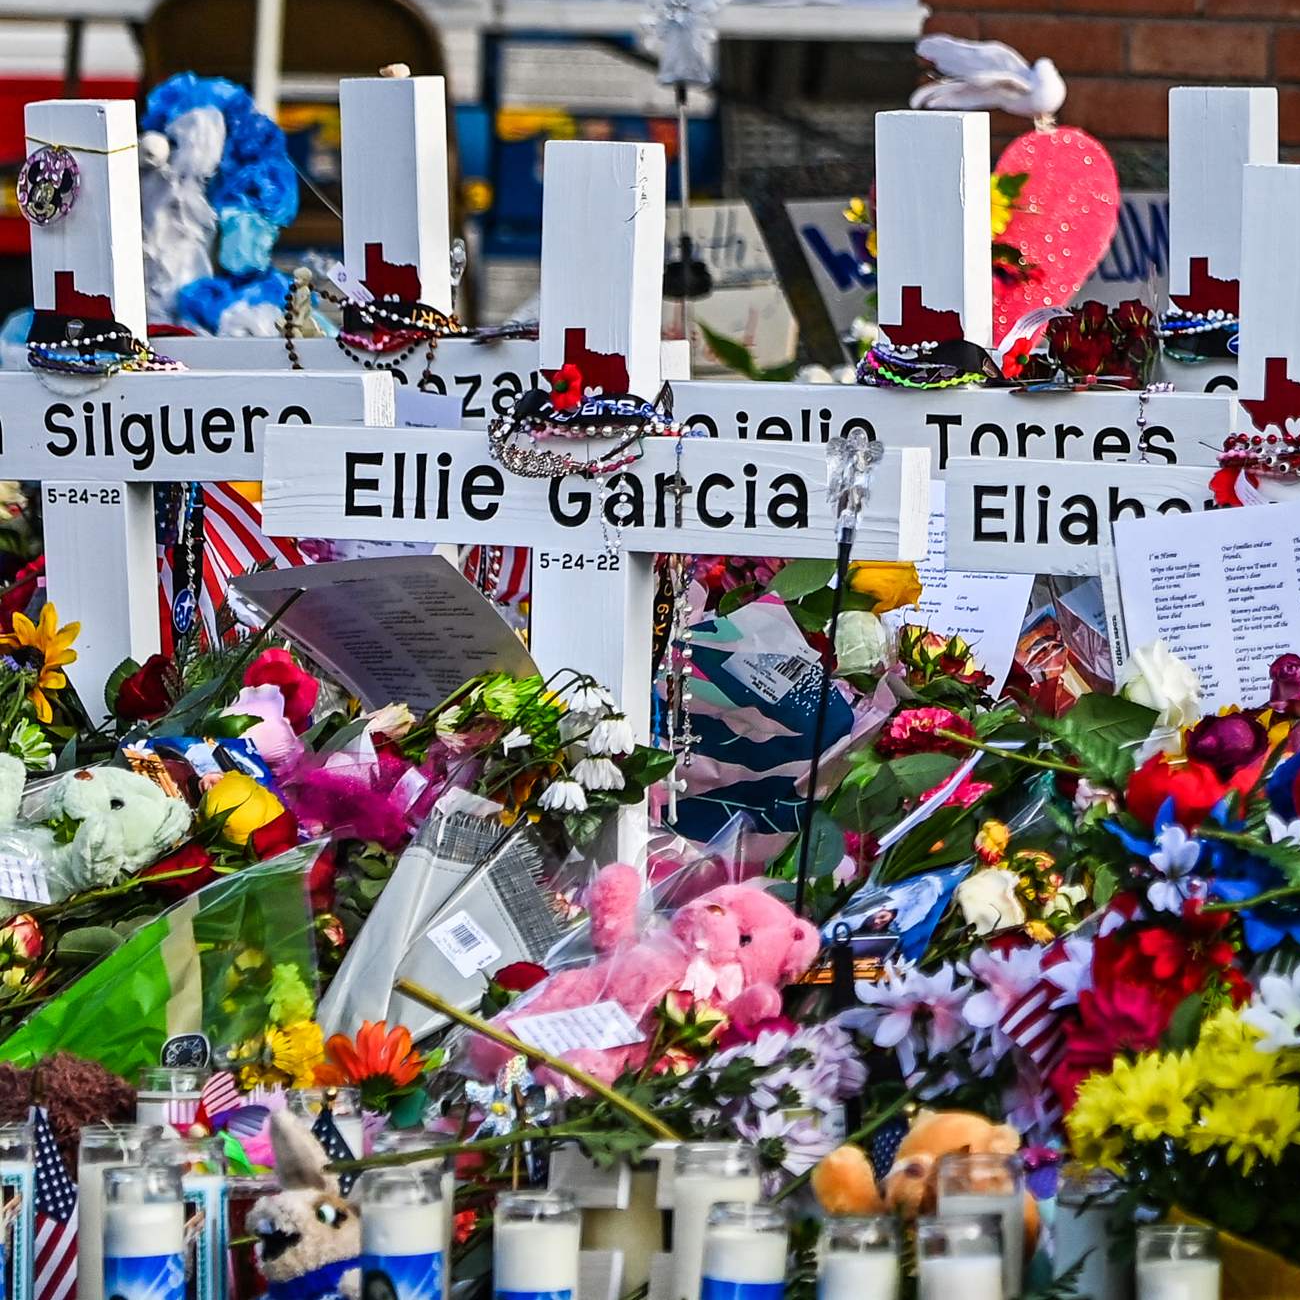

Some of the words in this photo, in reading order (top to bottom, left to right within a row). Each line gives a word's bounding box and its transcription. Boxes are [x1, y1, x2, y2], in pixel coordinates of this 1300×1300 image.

[539, 399, 637, 422] SUBRU
[926, 413, 1176, 471] Torres
[47, 486, 121, 505] 5-24-22
[344, 451, 505, 521] Ellie
[547, 464, 809, 530] Garcia
[538, 553, 620, 572] 5-24-22
